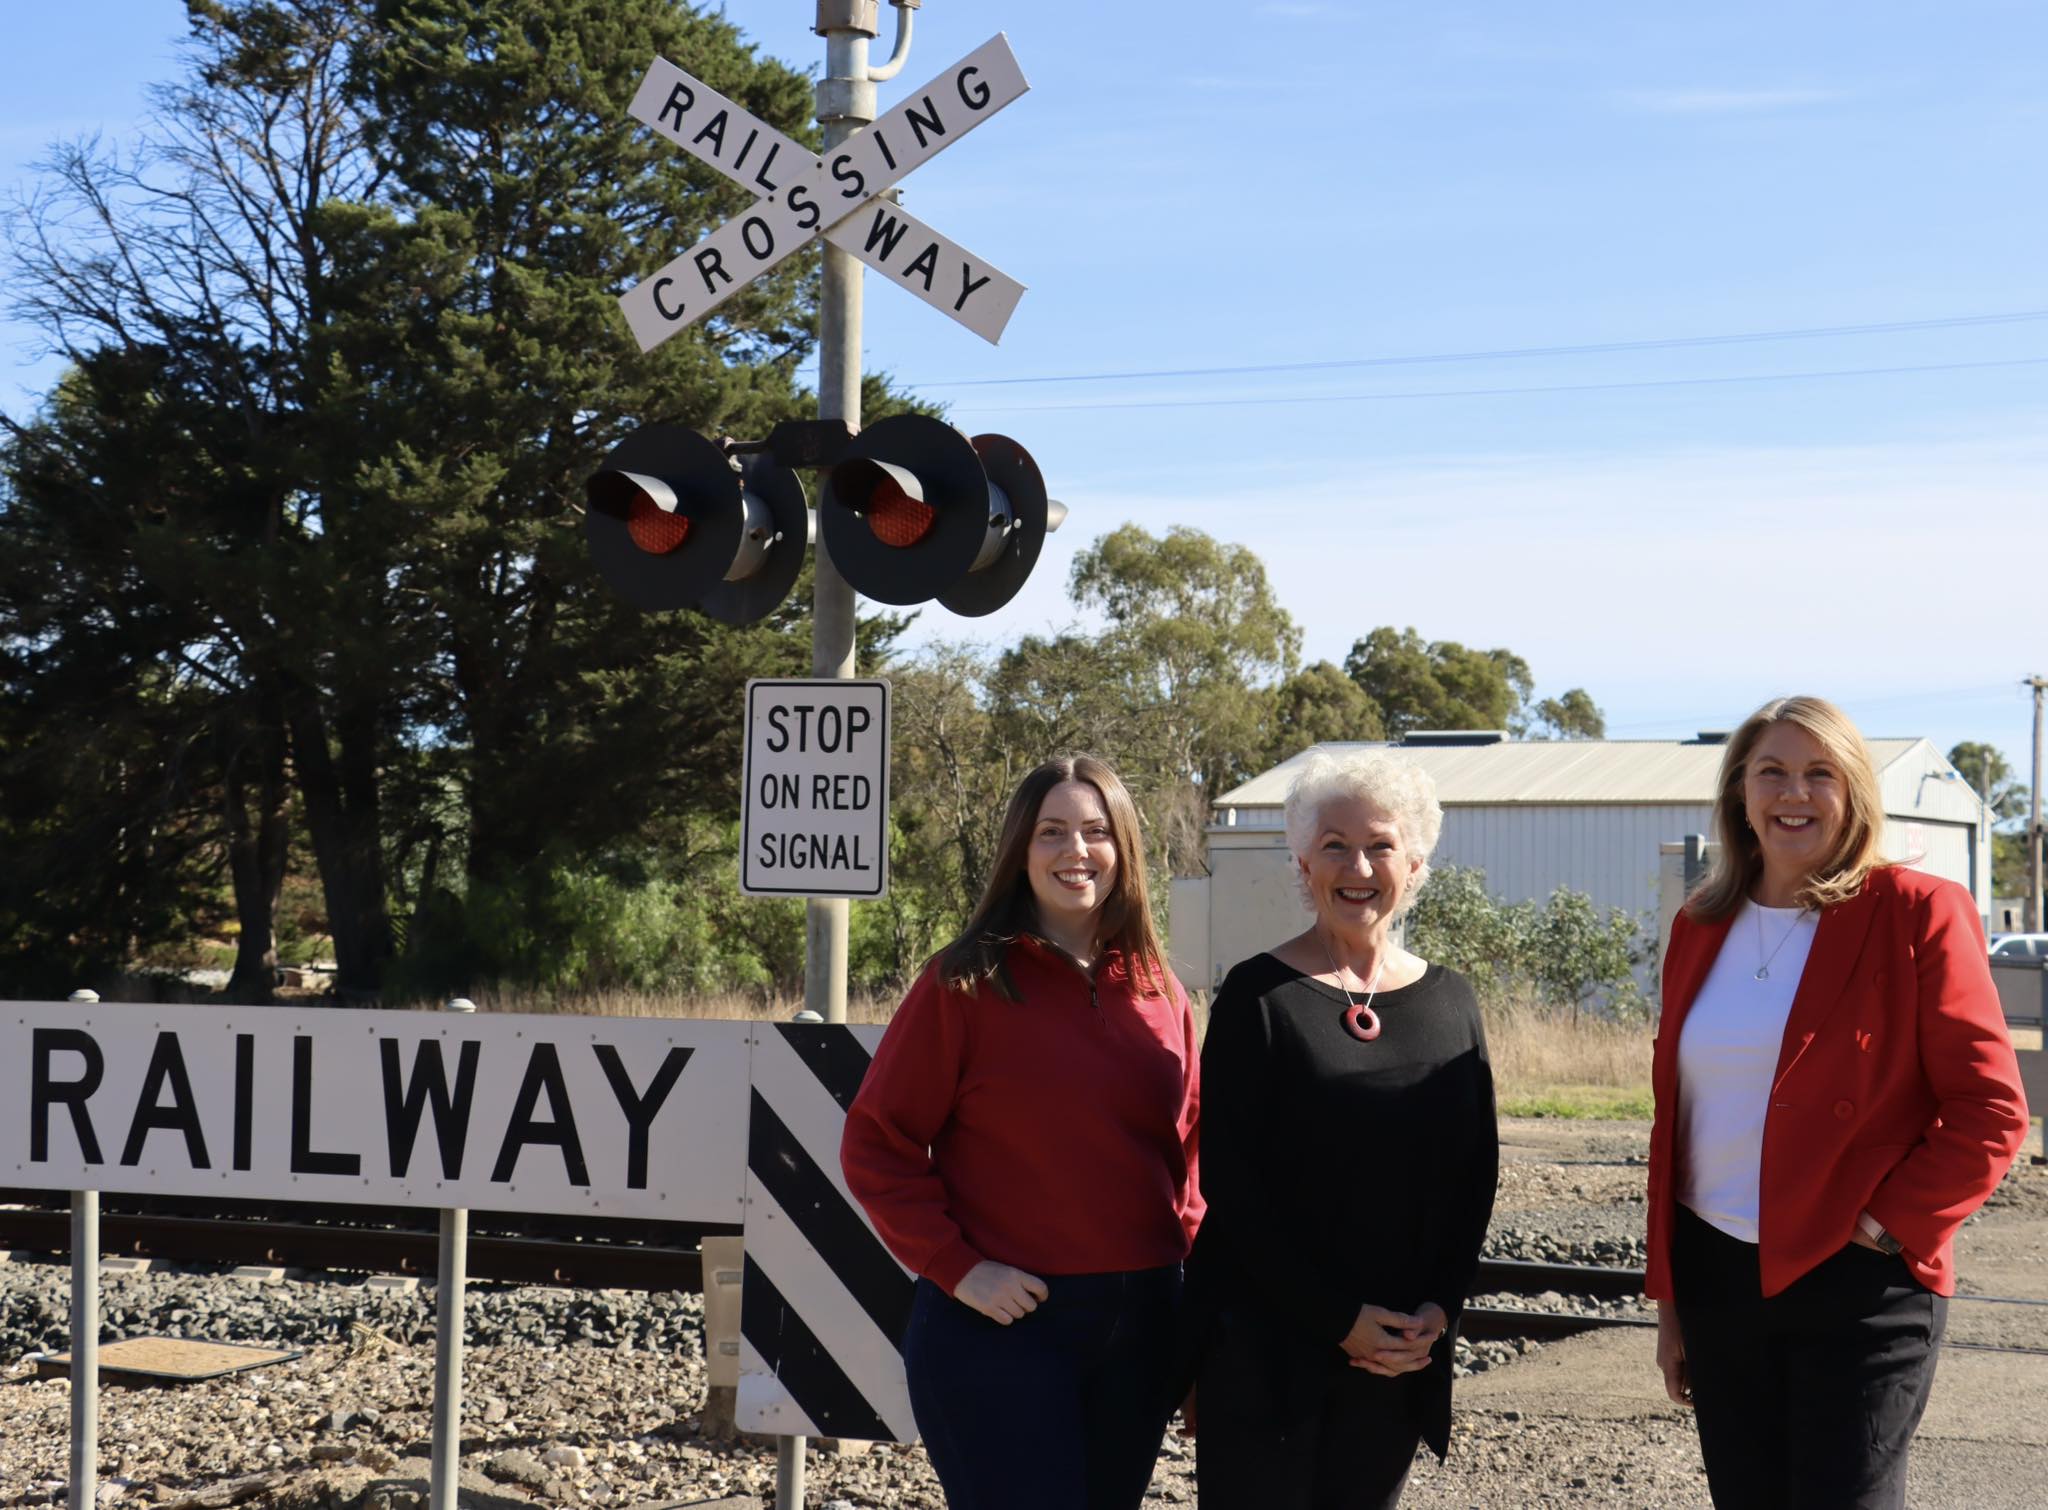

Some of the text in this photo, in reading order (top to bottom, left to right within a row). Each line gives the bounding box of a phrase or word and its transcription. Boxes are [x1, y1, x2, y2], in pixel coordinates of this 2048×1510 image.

[653, 66, 991, 321] CROSSING
[766, 705, 871, 753] STOP
[760, 773, 871, 810] ON RED
[759, 832, 870, 871] SIGNAL
[30, 1027, 696, 1190] RAILWAY
